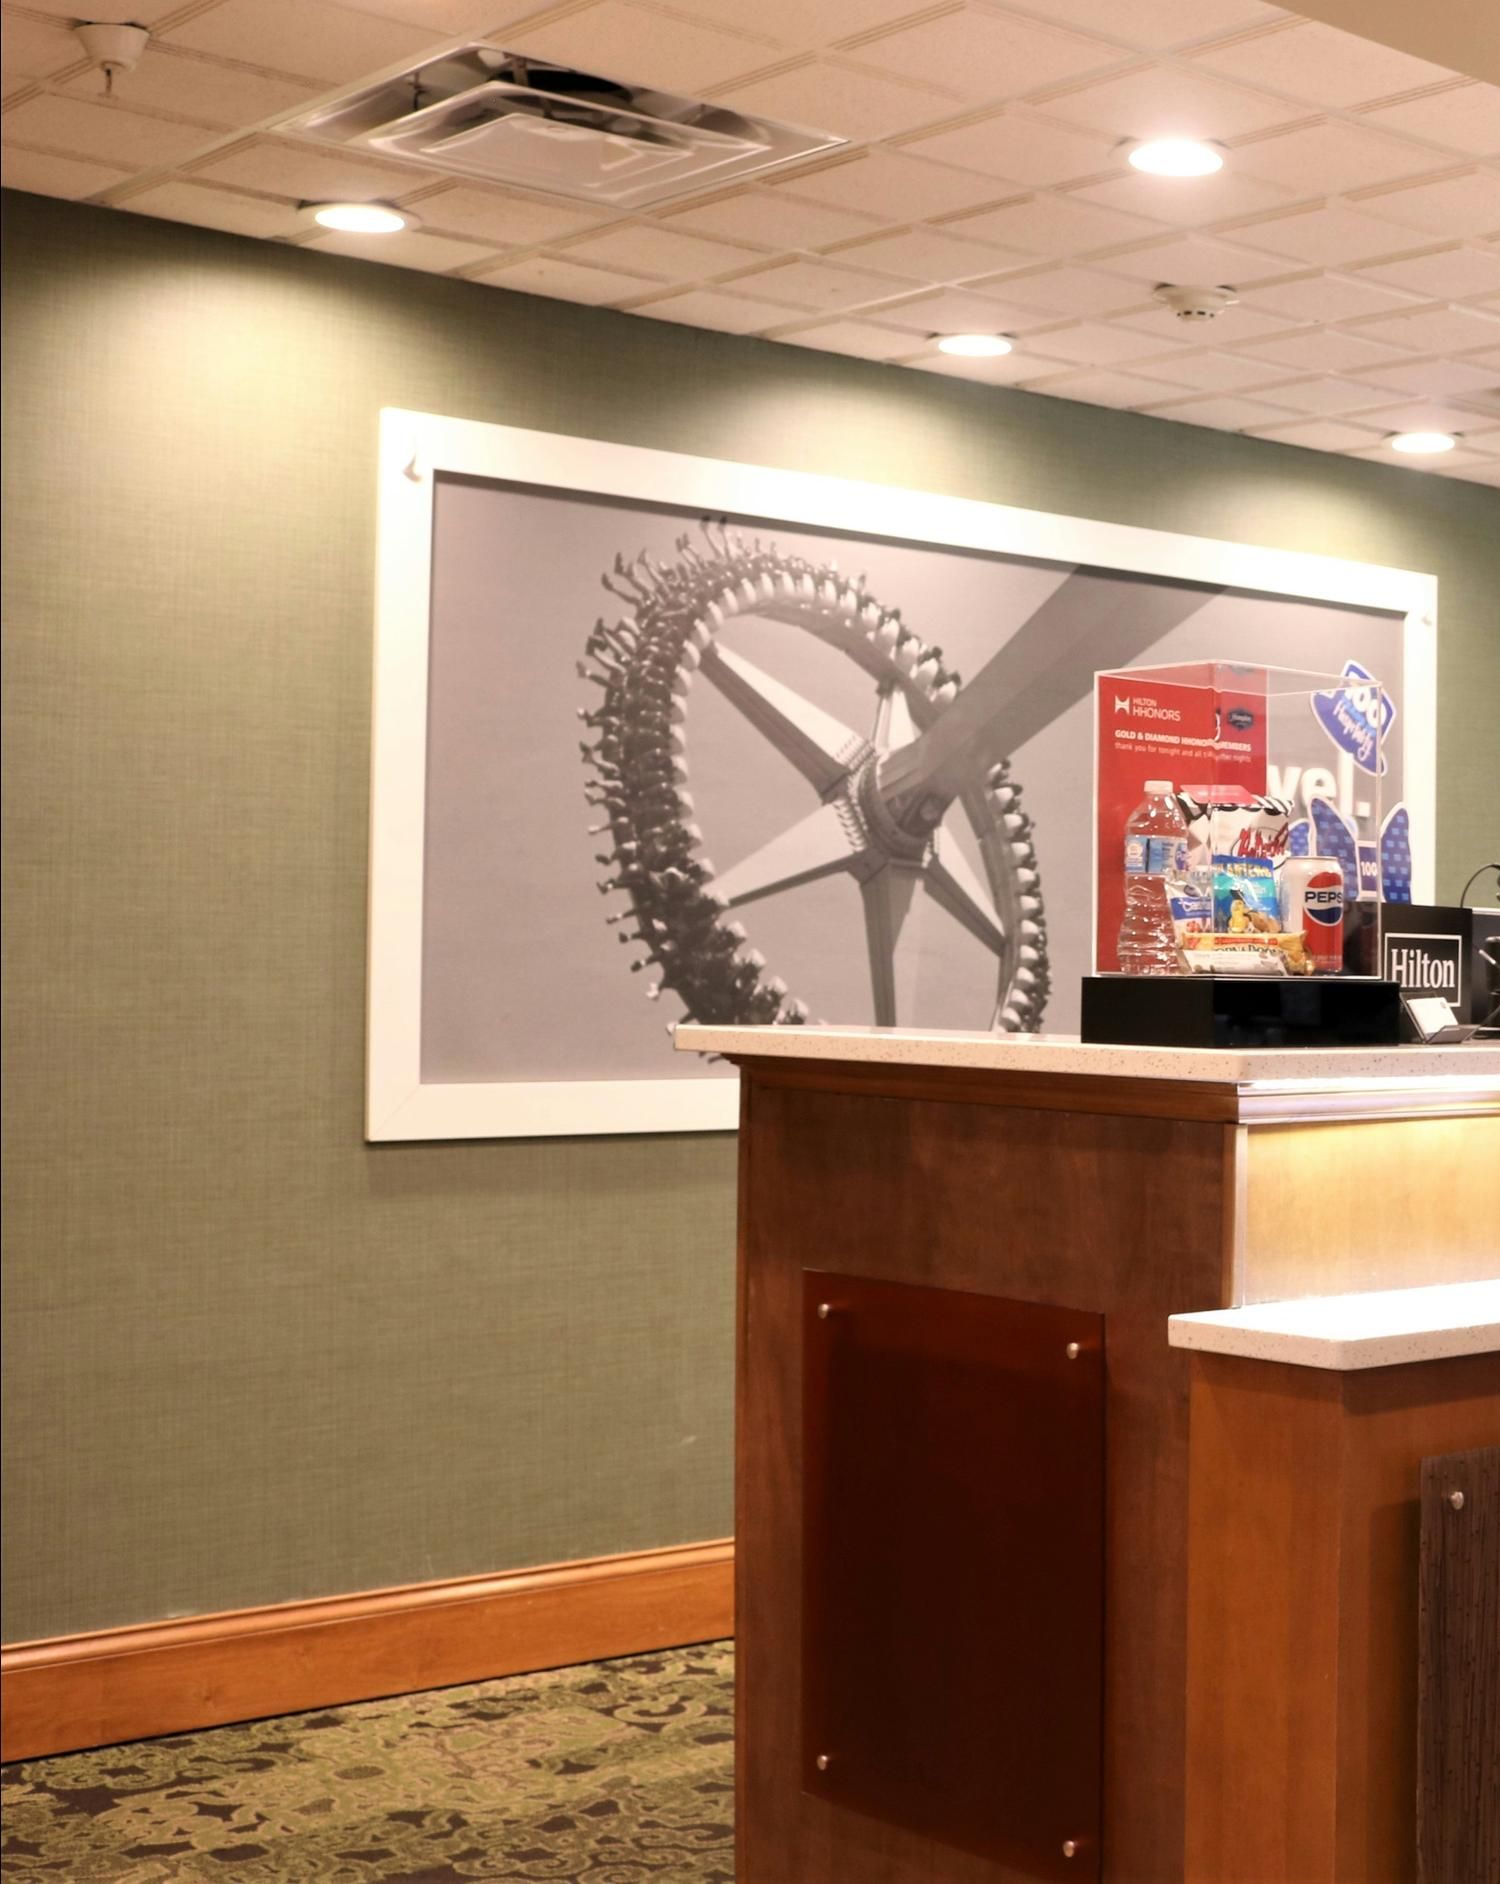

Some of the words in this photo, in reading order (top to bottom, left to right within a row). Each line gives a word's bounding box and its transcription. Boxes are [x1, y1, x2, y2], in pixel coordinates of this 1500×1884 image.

[1132, 698, 1157, 706] HILTON
[1132, 707, 1181, 722] HHONORS
[1115, 729, 1136, 740] GOLD
[1137, 732, 1143, 741] &
[1145, 732, 1180, 745] DIAMOND
[1360, 861, 1378, 876] 100
[1391, 948, 1455, 989] Hilton
